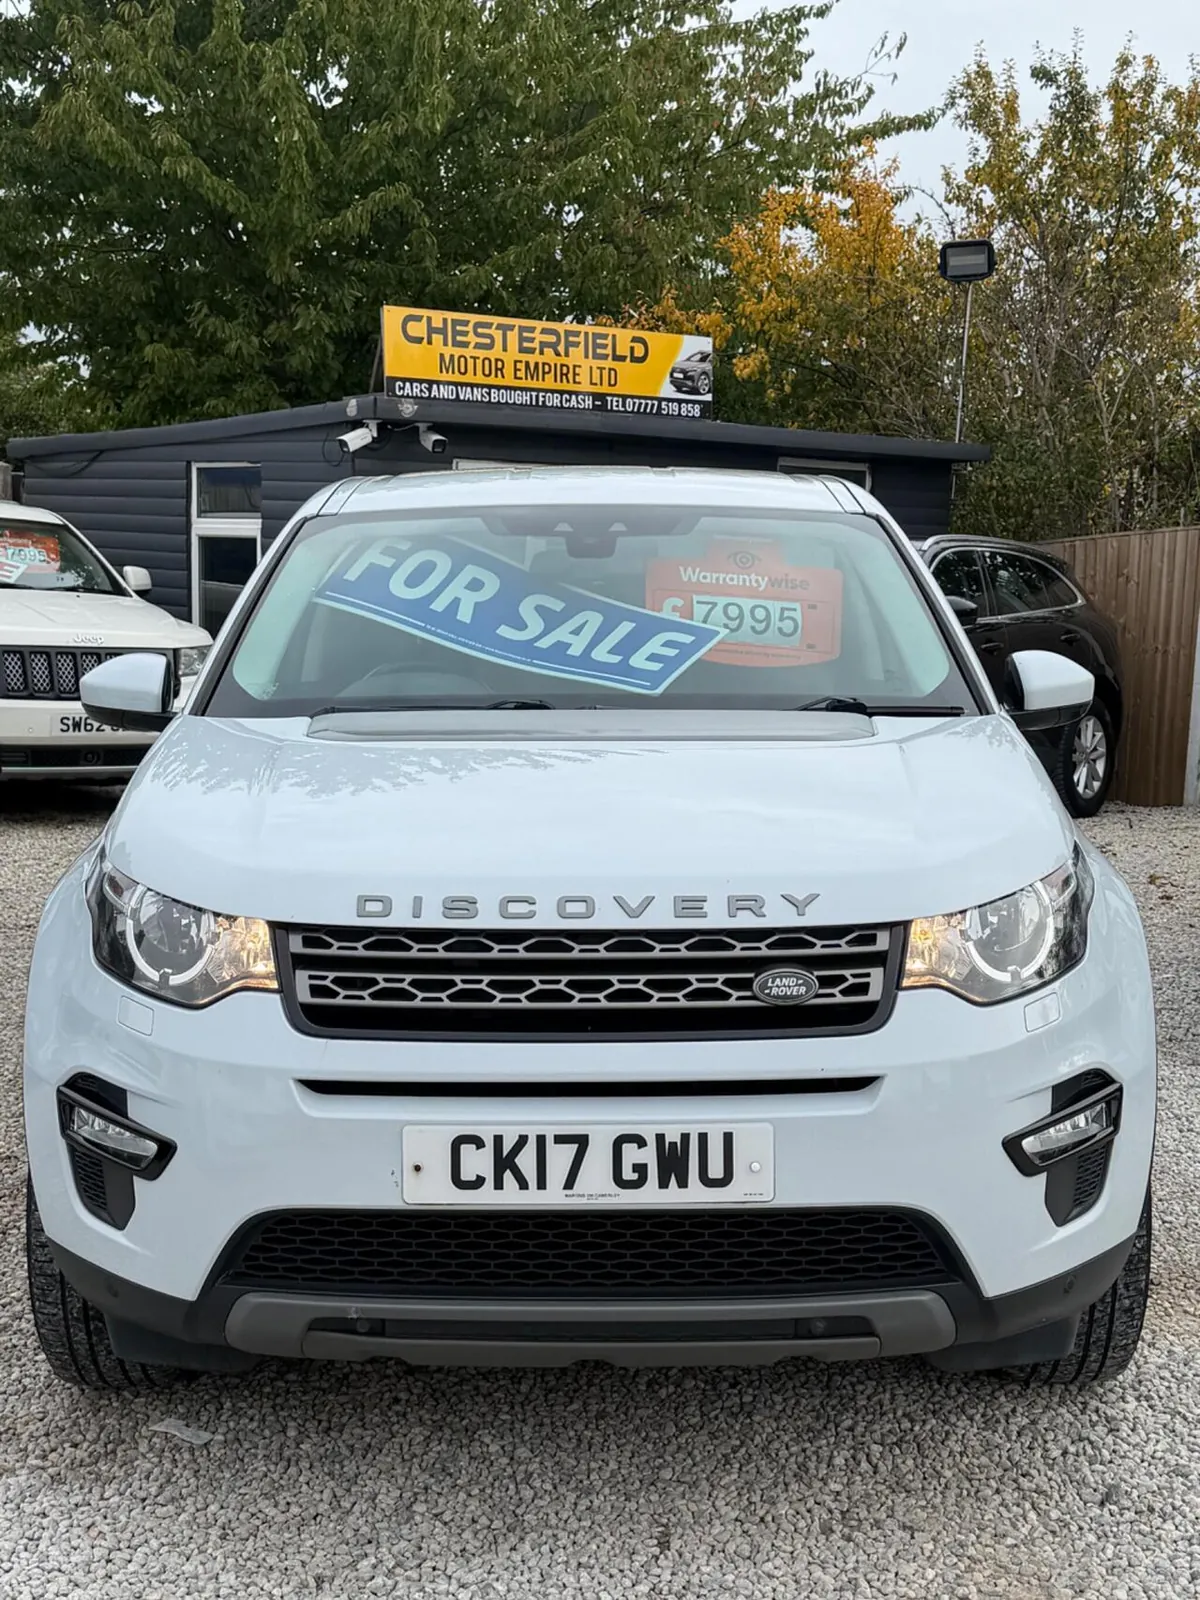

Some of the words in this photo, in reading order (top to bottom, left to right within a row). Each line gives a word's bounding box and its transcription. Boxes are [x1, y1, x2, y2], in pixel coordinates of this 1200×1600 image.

[401, 314, 649, 364] CHESTERFIELD
[439, 353, 506, 379] MOTOR
[513, 360, 582, 385] EMPIRE
[589, 365, 618, 387] LTD
[395, 381, 429, 397] CARS
[430, 384, 456, 400] AND
[457, 386, 490, 402] VANS
[490, 389, 538, 406] BOUGHT
[540, 392, 561, 408] FOR
[562, 394, 593, 410] CASH
[606, 396, 626, 412] TEL
[626, 398, 658, 414] 07777
[661, 402, 679, 417] 519
[680, 403, 701, 418] 858
[679, 566, 811, 592] Warrantywise
[343, 537, 500, 624] FOR
[496, 594, 695, 671] SALE
[696, 600, 800, 638] 7995
[73, 634, 104, 645] Jeep
[356, 893, 820, 919] DISCOVERY
[450, 1133, 590, 1191] CK17
[612, 1131, 734, 1190] GWU
